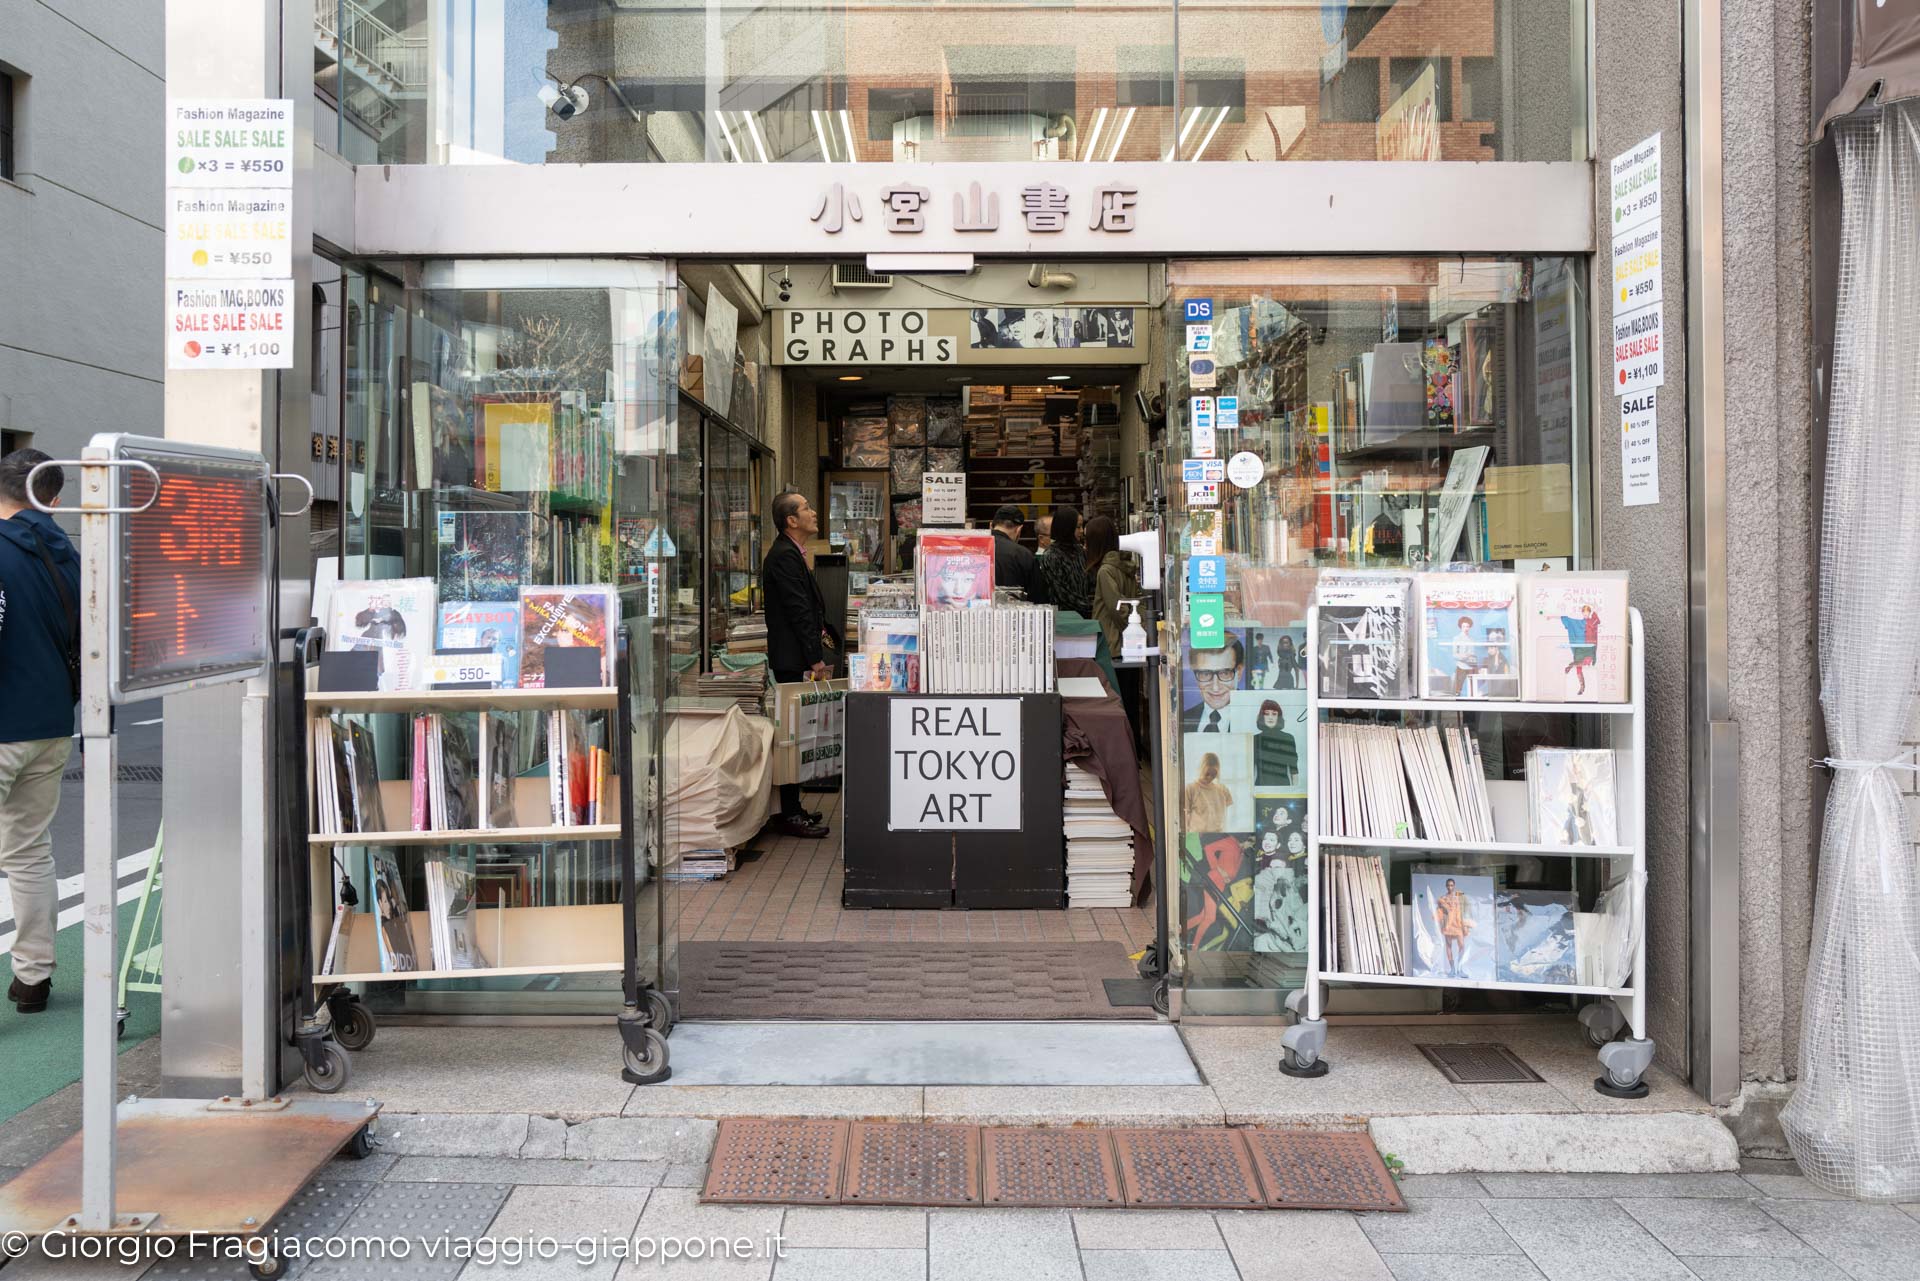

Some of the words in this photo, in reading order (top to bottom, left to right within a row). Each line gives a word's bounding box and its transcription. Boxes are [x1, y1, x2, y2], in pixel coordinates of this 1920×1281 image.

[177, 107, 224, 120] Fashion
[227, 107, 285, 122] Magazine
[177, 130, 211, 148] SALE
[214, 130, 248, 148] SALE
[252, 130, 285, 148] SALE
[241, 160, 284, 172] ¥550
[1614, 179, 1628, 200] SALE
[1628, 171, 1642, 193] SALE
[1643, 163, 1658, 185] SALE
[177, 200, 224, 212] Fashion
[227, 200, 285, 214] Magazine
[810, 180, 1139, 234] 小宮山書店
[1639, 191, 1658, 209] ¥550
[178, 223, 211, 240] SALE
[215, 223, 248, 240] SALE
[252, 222, 286, 239] SALE
[1615, 242, 1633, 257] Fashion
[1634, 231, 1658, 248] Magazine
[229, 251, 272, 264] ¥550
[1636, 279, 1654, 296] ¥550
[177, 290, 217, 308] Fashion
[1187, 302, 1211, 317] DS
[176, 314, 209, 332] SALE
[213, 314, 246, 332] SALE
[250, 312, 283, 331] SALE
[790, 310, 925, 334] PHOTO
[221, 343, 280, 358] ¥1,100
[786, 337, 951, 362] GRAPHS
[1615, 343, 1628, 363] SALE
[1629, 339, 1643, 358] SALE
[1643, 335, 1659, 354] SALE
[1633, 363, 1658, 380] ¥1,100
[1623, 395, 1654, 415] SALE
[1206, 461, 1222, 473] VISA
[924, 476, 963, 485] SALE
[912, 707, 1002, 736] REAL
[894, 749, 1016, 781] TOKYO
[919, 793, 992, 823] ART
